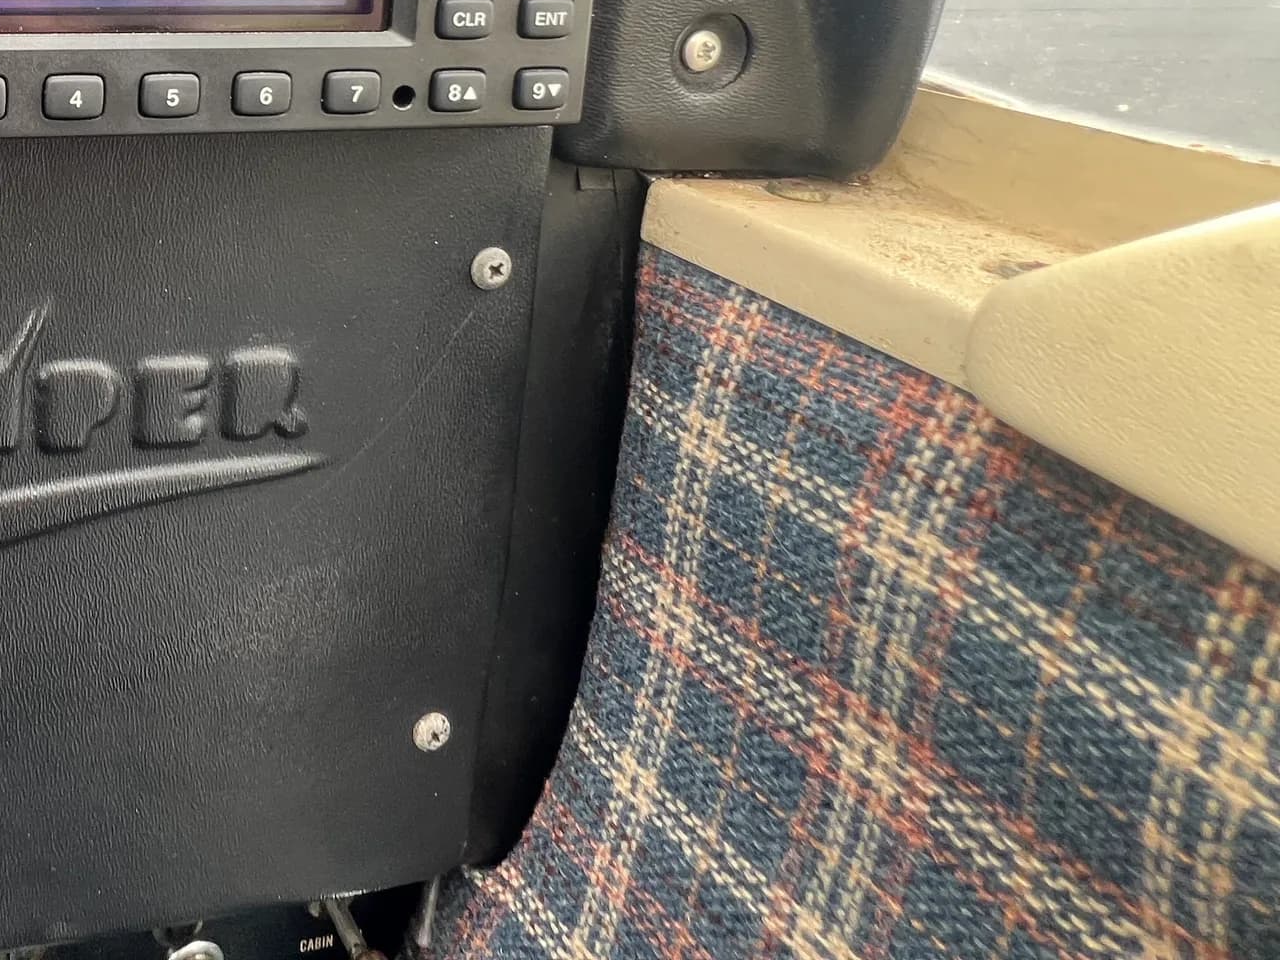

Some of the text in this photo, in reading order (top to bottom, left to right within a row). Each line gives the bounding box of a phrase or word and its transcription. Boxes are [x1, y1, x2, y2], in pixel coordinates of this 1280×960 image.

[453, 12, 487, 27] CLR
[535, 12, 568, 27] ENT
[68, 90, 84, 110] 4
[166, 88, 180, 108] 5
[259, 86, 273, 106] 6
[351, 85, 364, 104] 7
[448, 84, 462, 101] 8
[532, 83, 546, 100] 9
[300, 934, 334, 953] CABIN
